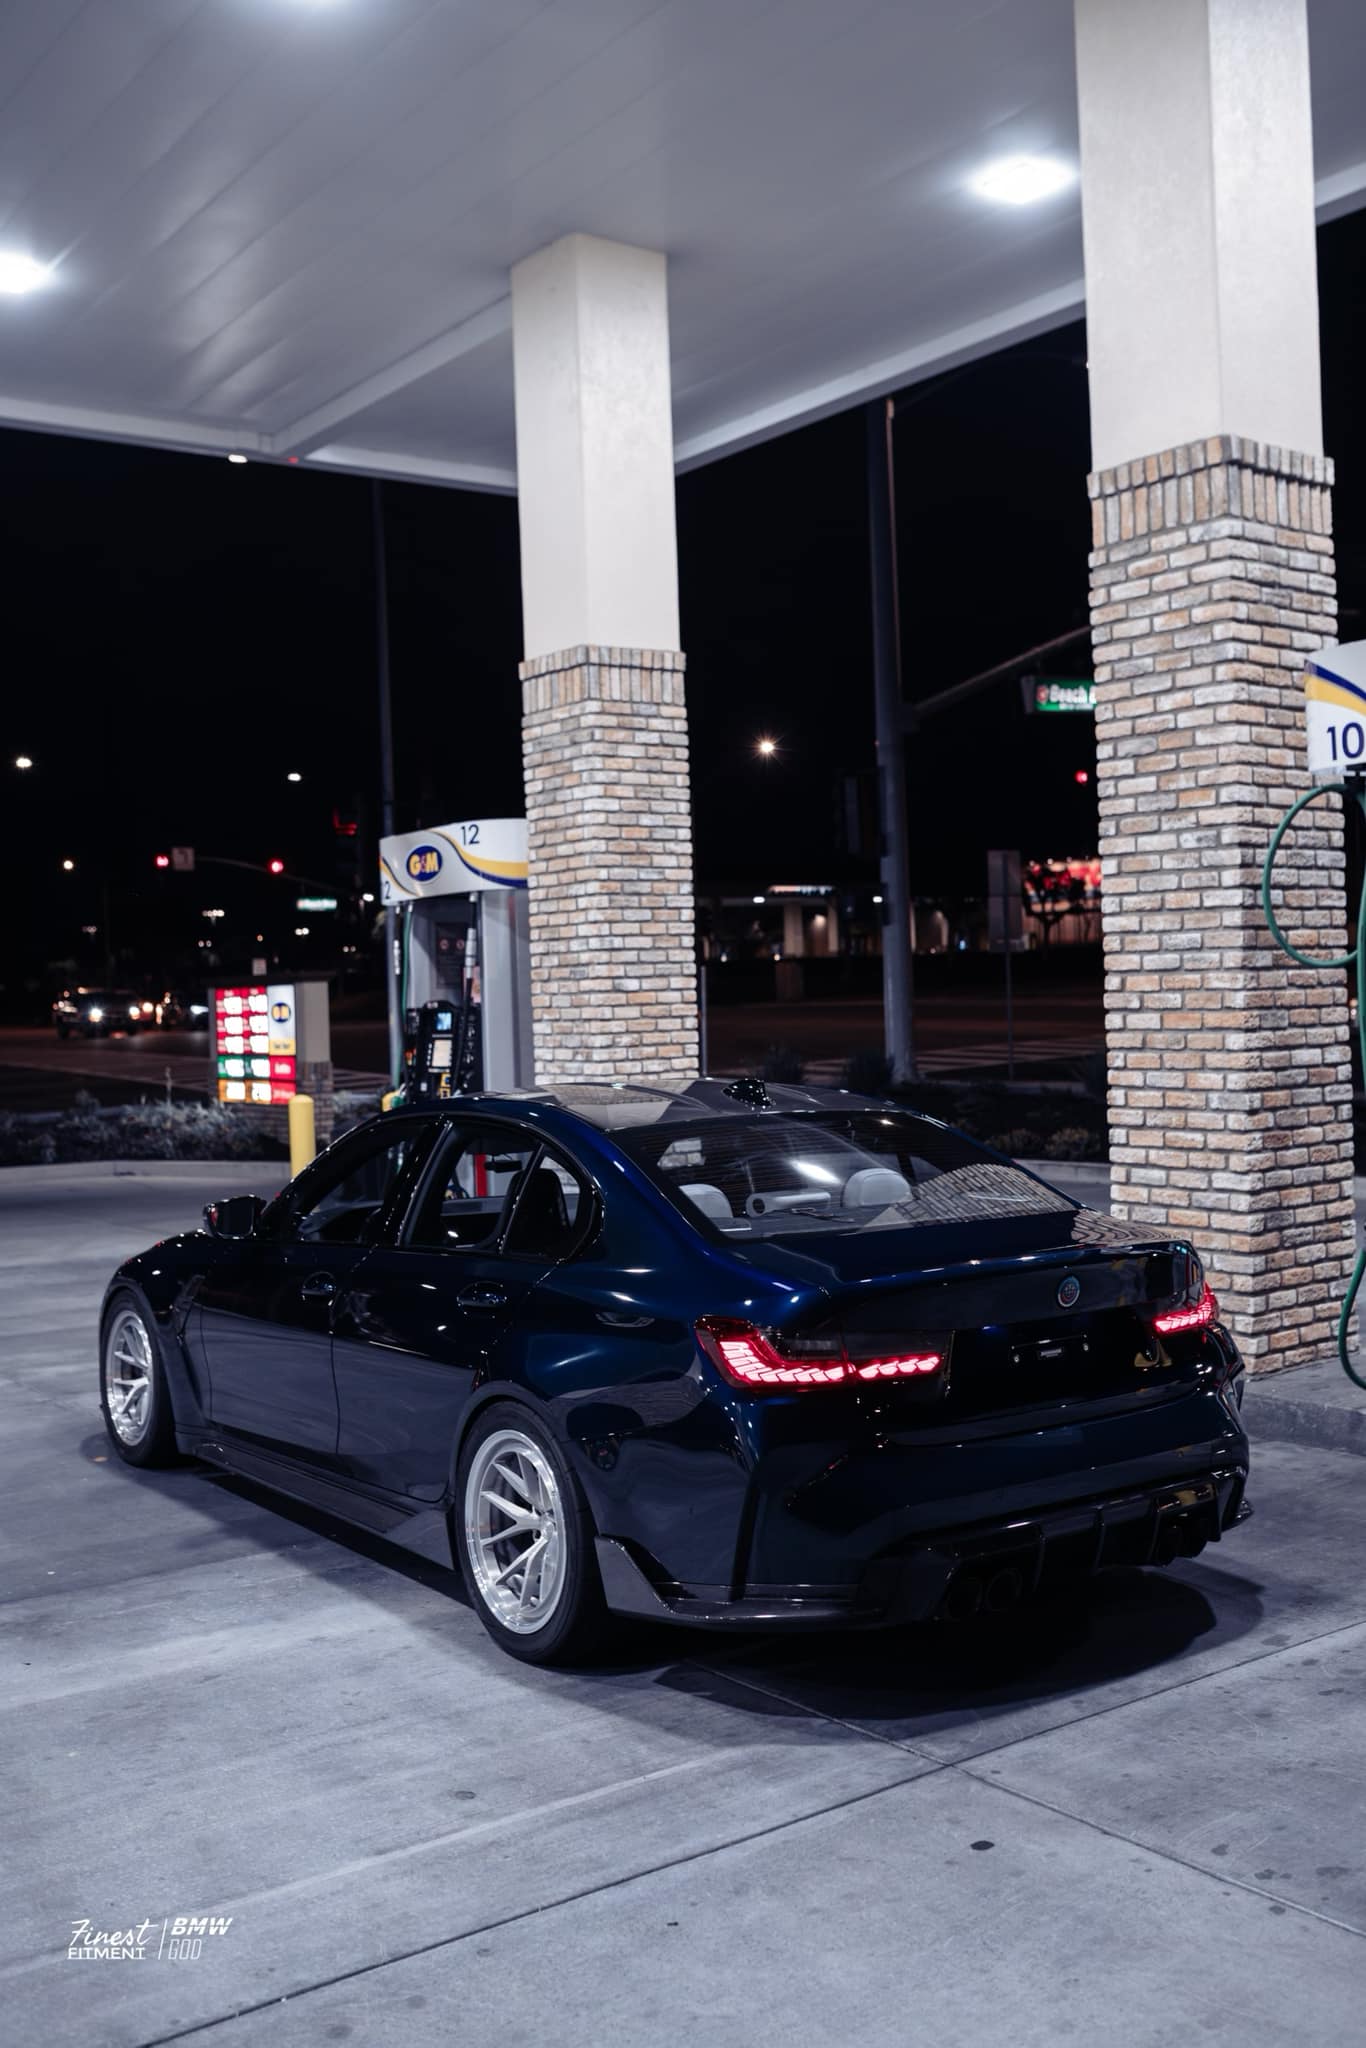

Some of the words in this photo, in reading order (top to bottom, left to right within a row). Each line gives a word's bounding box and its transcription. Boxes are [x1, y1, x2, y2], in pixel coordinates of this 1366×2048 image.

[1326, 721, 1365, 761] 10
[461, 824, 480, 845] 12
[408, 851, 439, 876] G&M
